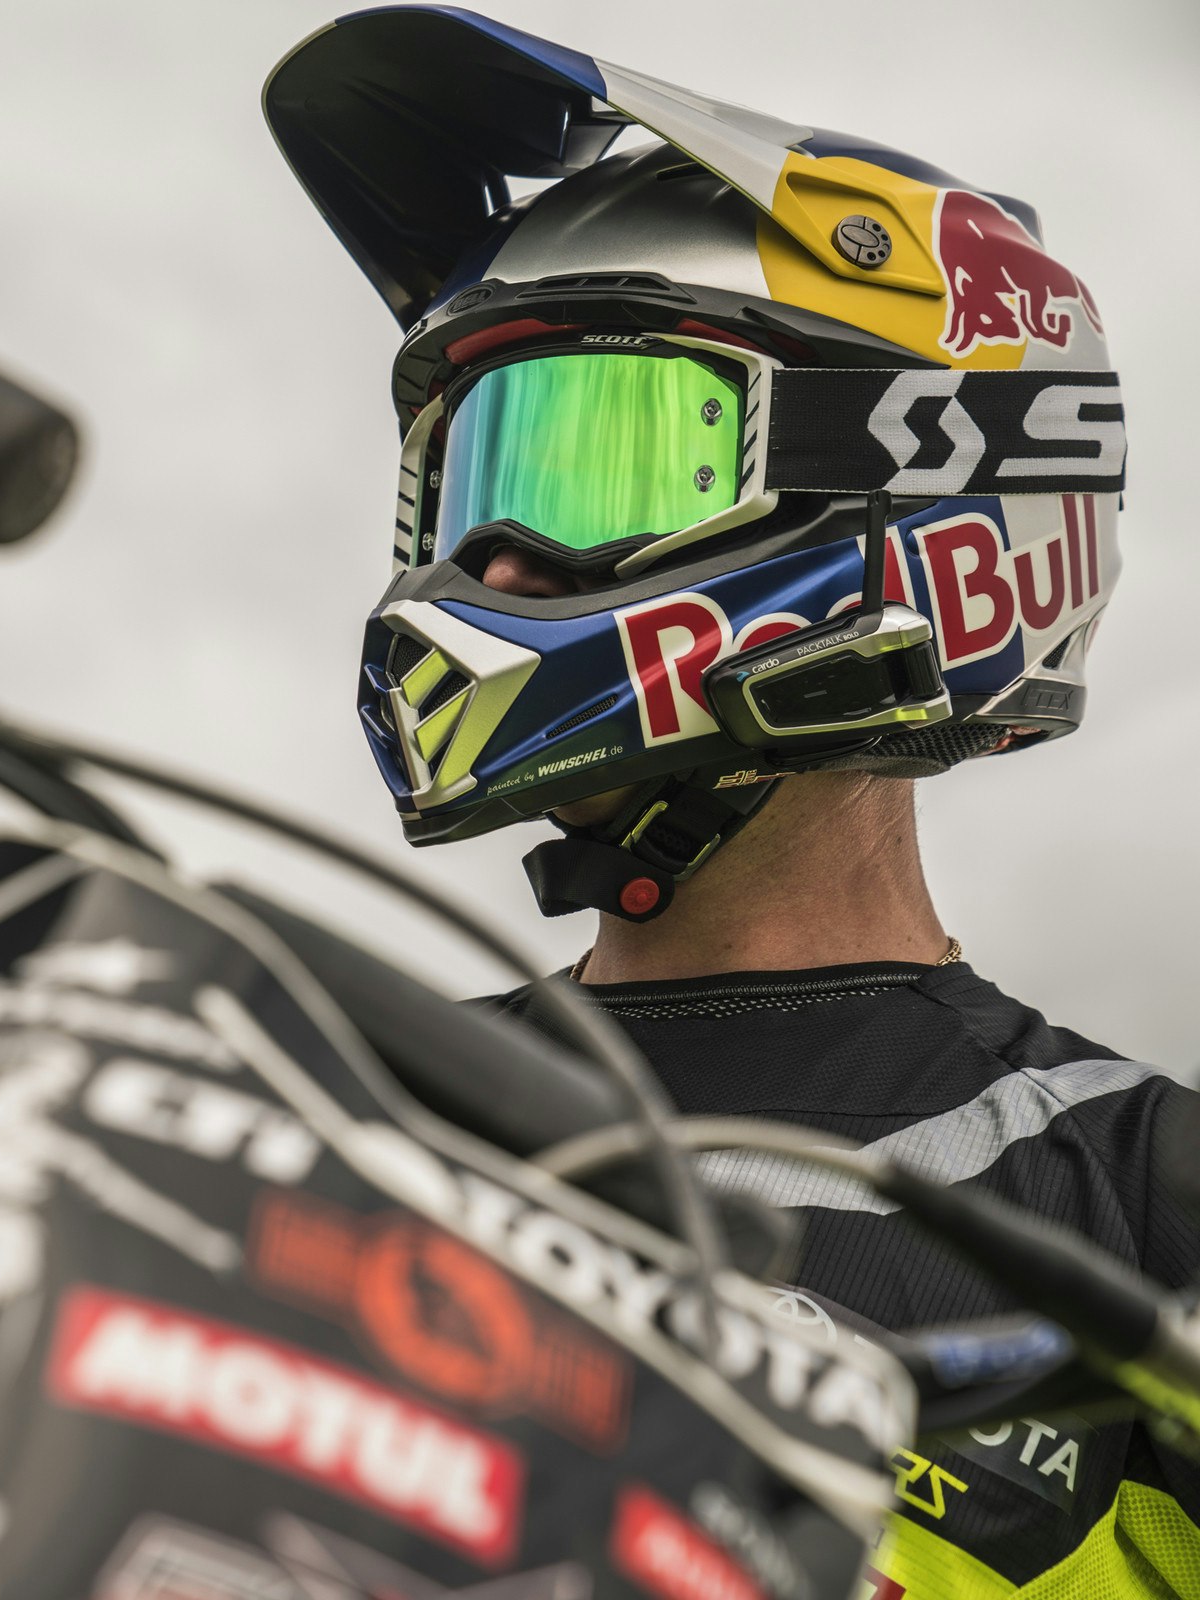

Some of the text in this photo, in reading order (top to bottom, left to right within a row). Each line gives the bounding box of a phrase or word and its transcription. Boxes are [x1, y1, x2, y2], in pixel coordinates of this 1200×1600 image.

[581, 334, 647, 345] SCOTT
[922, 494, 1099, 663] Bull
[751, 631, 860, 675] cardo PACKTALK BOLD
[486, 776, 520, 796] painted
[524, 772, 535, 781] by
[72, 1308, 500, 1540] MOTUL
